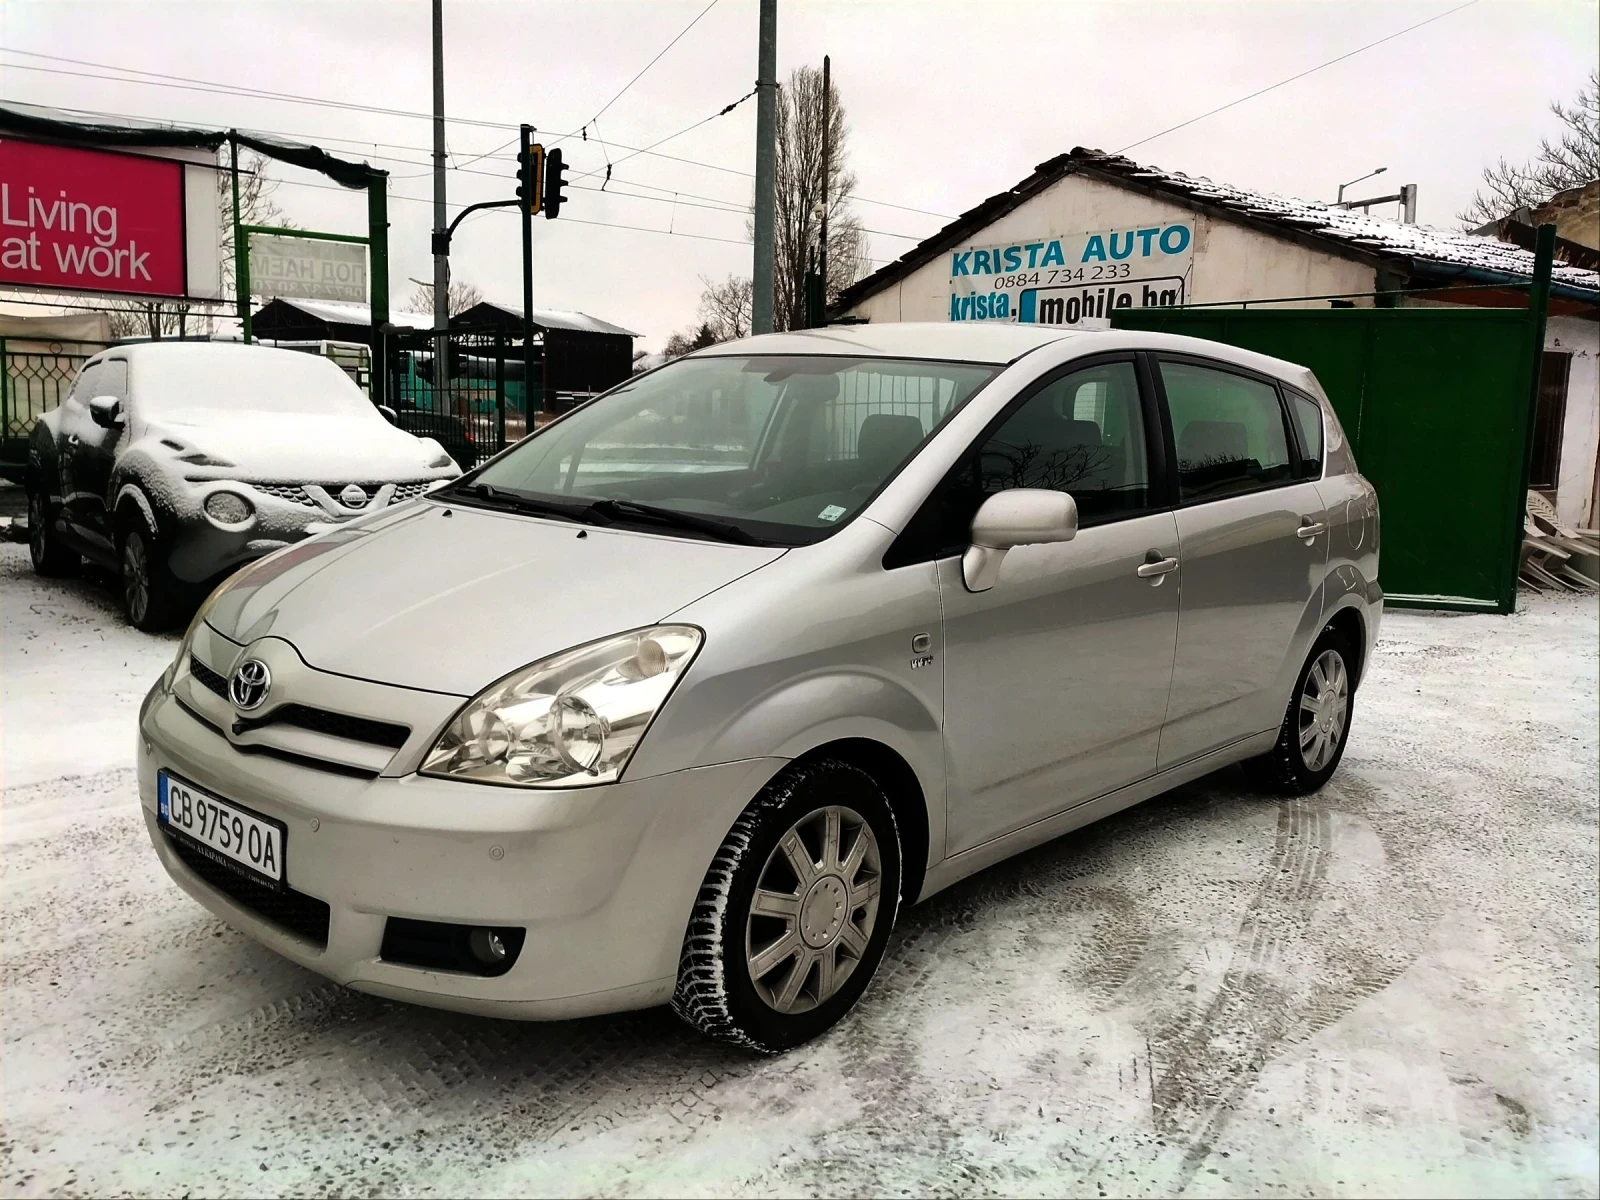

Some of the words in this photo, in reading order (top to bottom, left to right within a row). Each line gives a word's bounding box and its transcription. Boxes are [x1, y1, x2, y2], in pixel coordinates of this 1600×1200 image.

[2, 183, 117, 247] Living
[1, 231, 42, 271] at
[53, 241, 152, 281] work
[952, 240, 1065, 277] KRISTA
[1081, 225, 1191, 264] AUTO
[994, 272, 1040, 290] 0884
[1047, 267, 1085, 284] 734
[1091, 263, 1131, 280] 233
[196, 799, 244, 855] 9759
